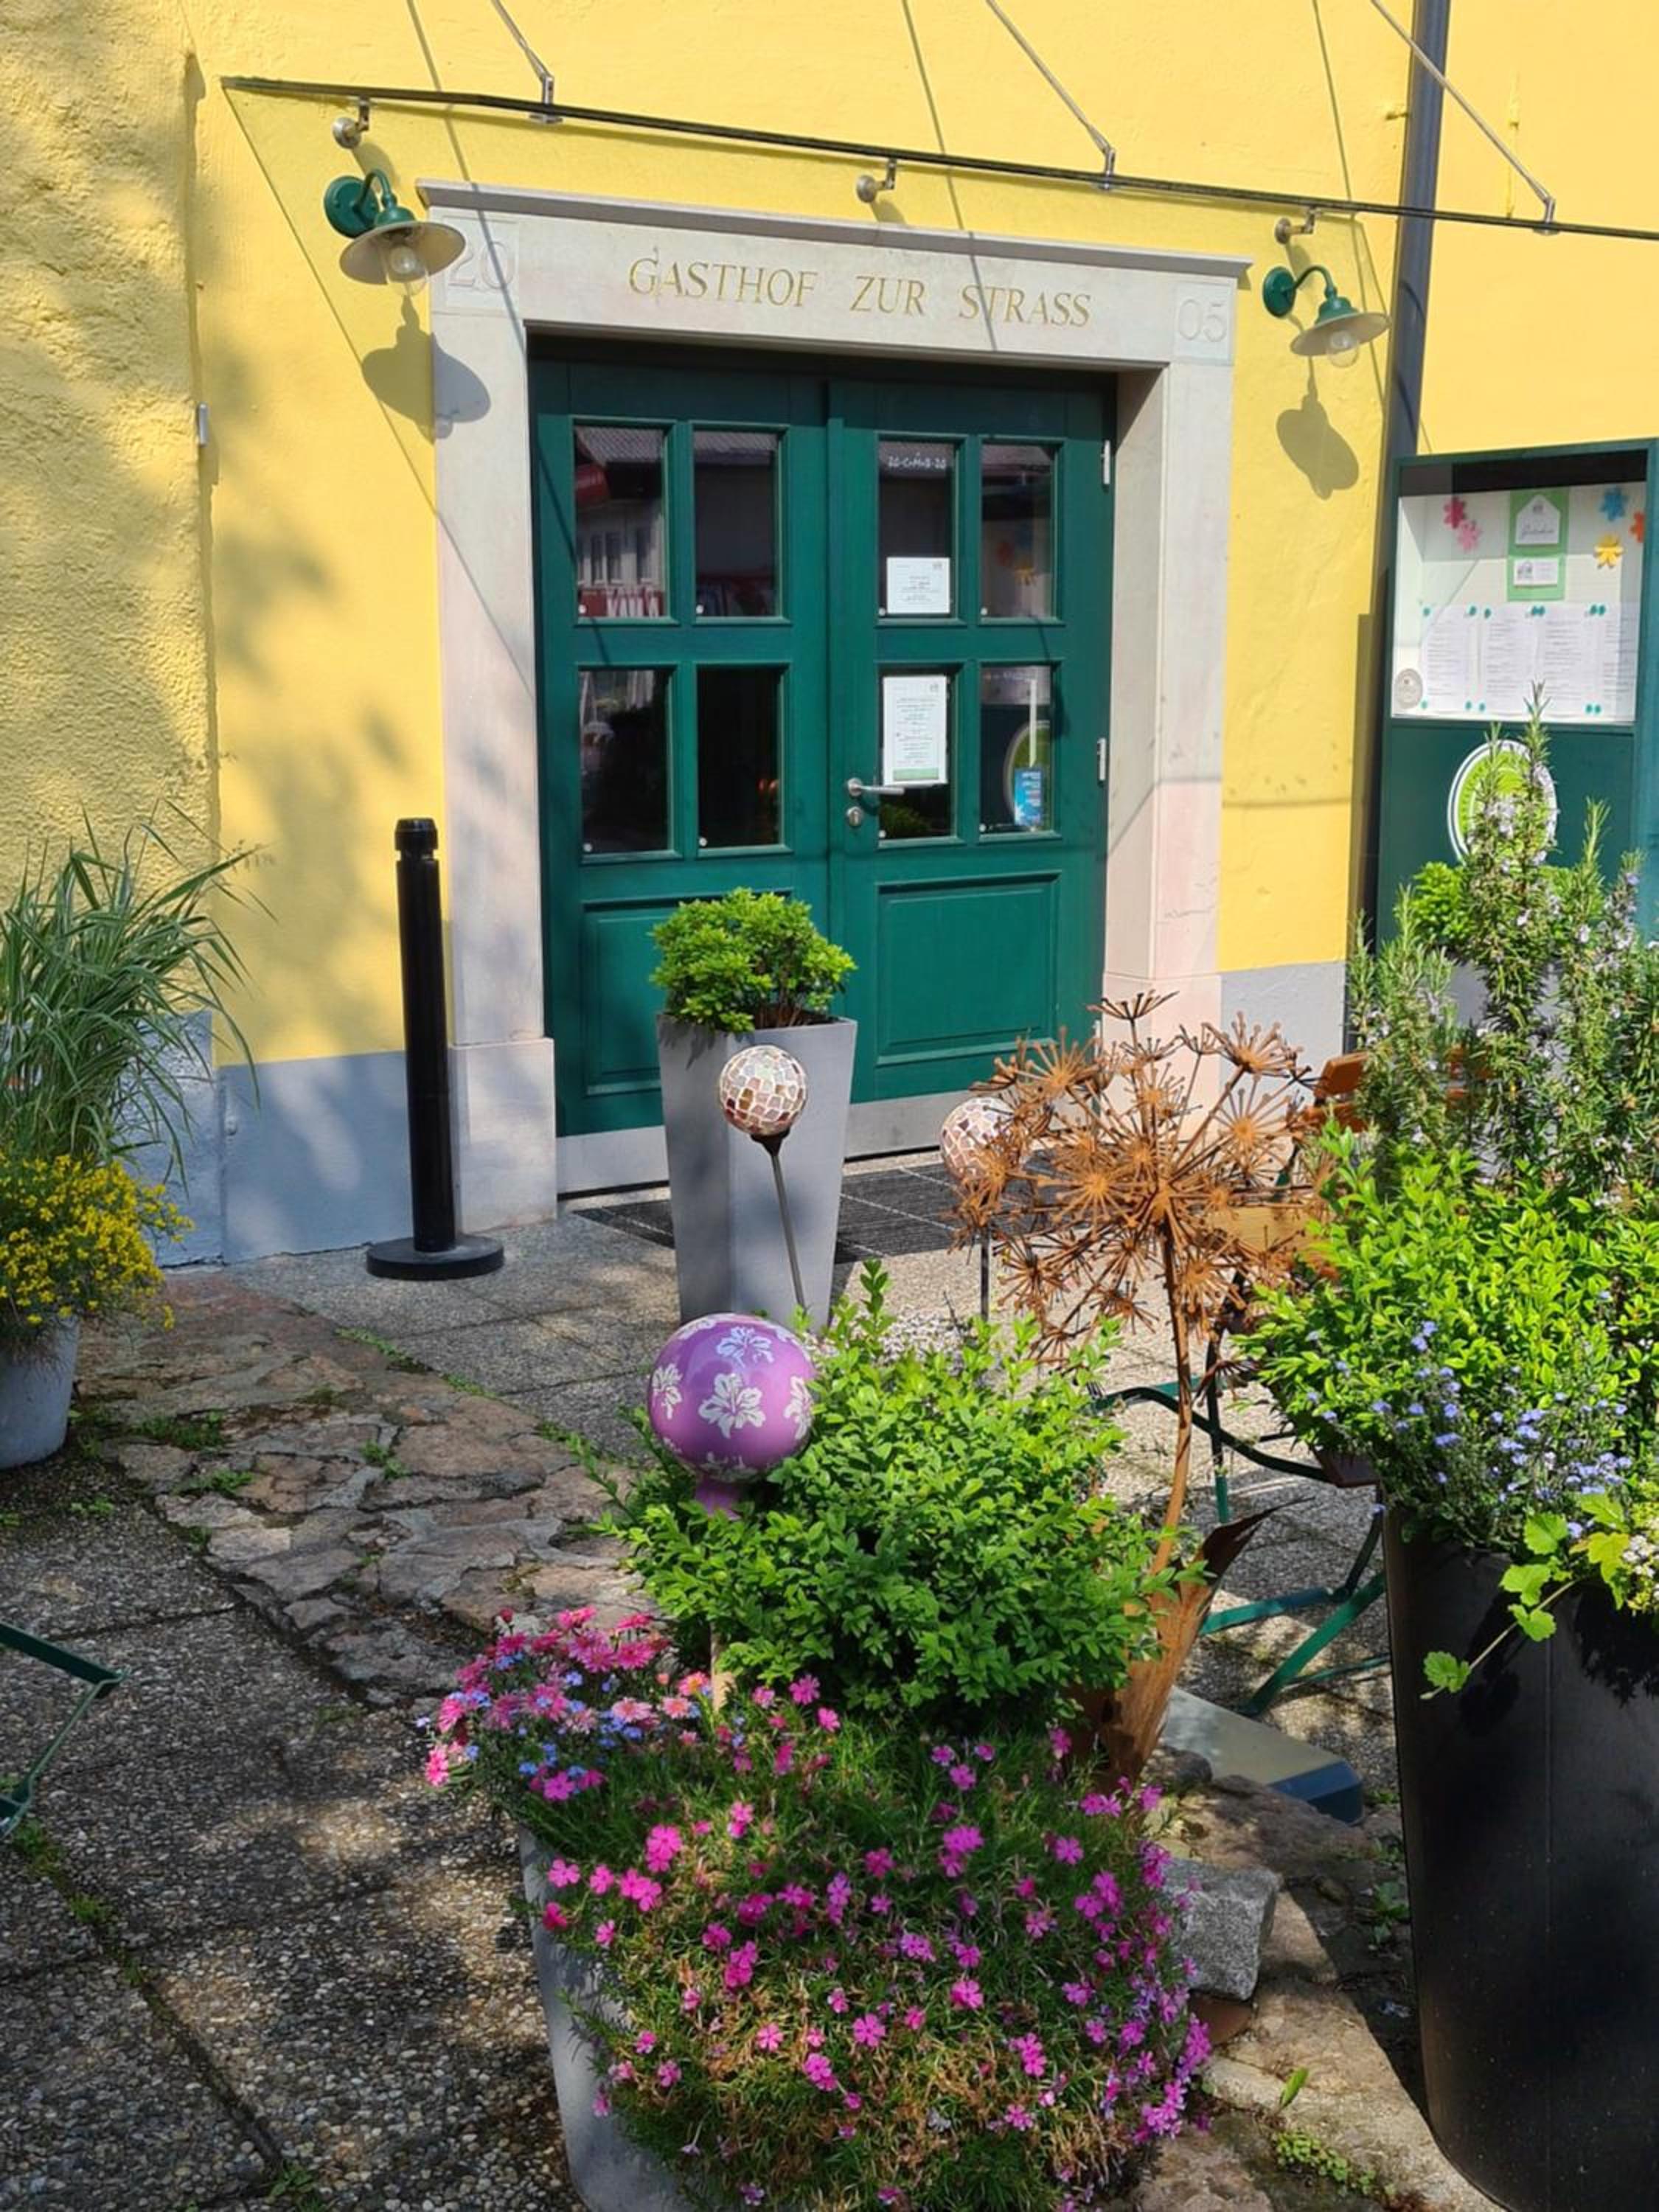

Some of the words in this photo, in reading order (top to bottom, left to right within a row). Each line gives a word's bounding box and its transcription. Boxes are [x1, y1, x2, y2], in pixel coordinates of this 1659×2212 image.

[628, 257, 818, 307] GASTHOF
[849, 276, 925, 316] ZUR
[959, 285, 1091, 327] STRASS
[1178, 298, 1228, 343] 05
